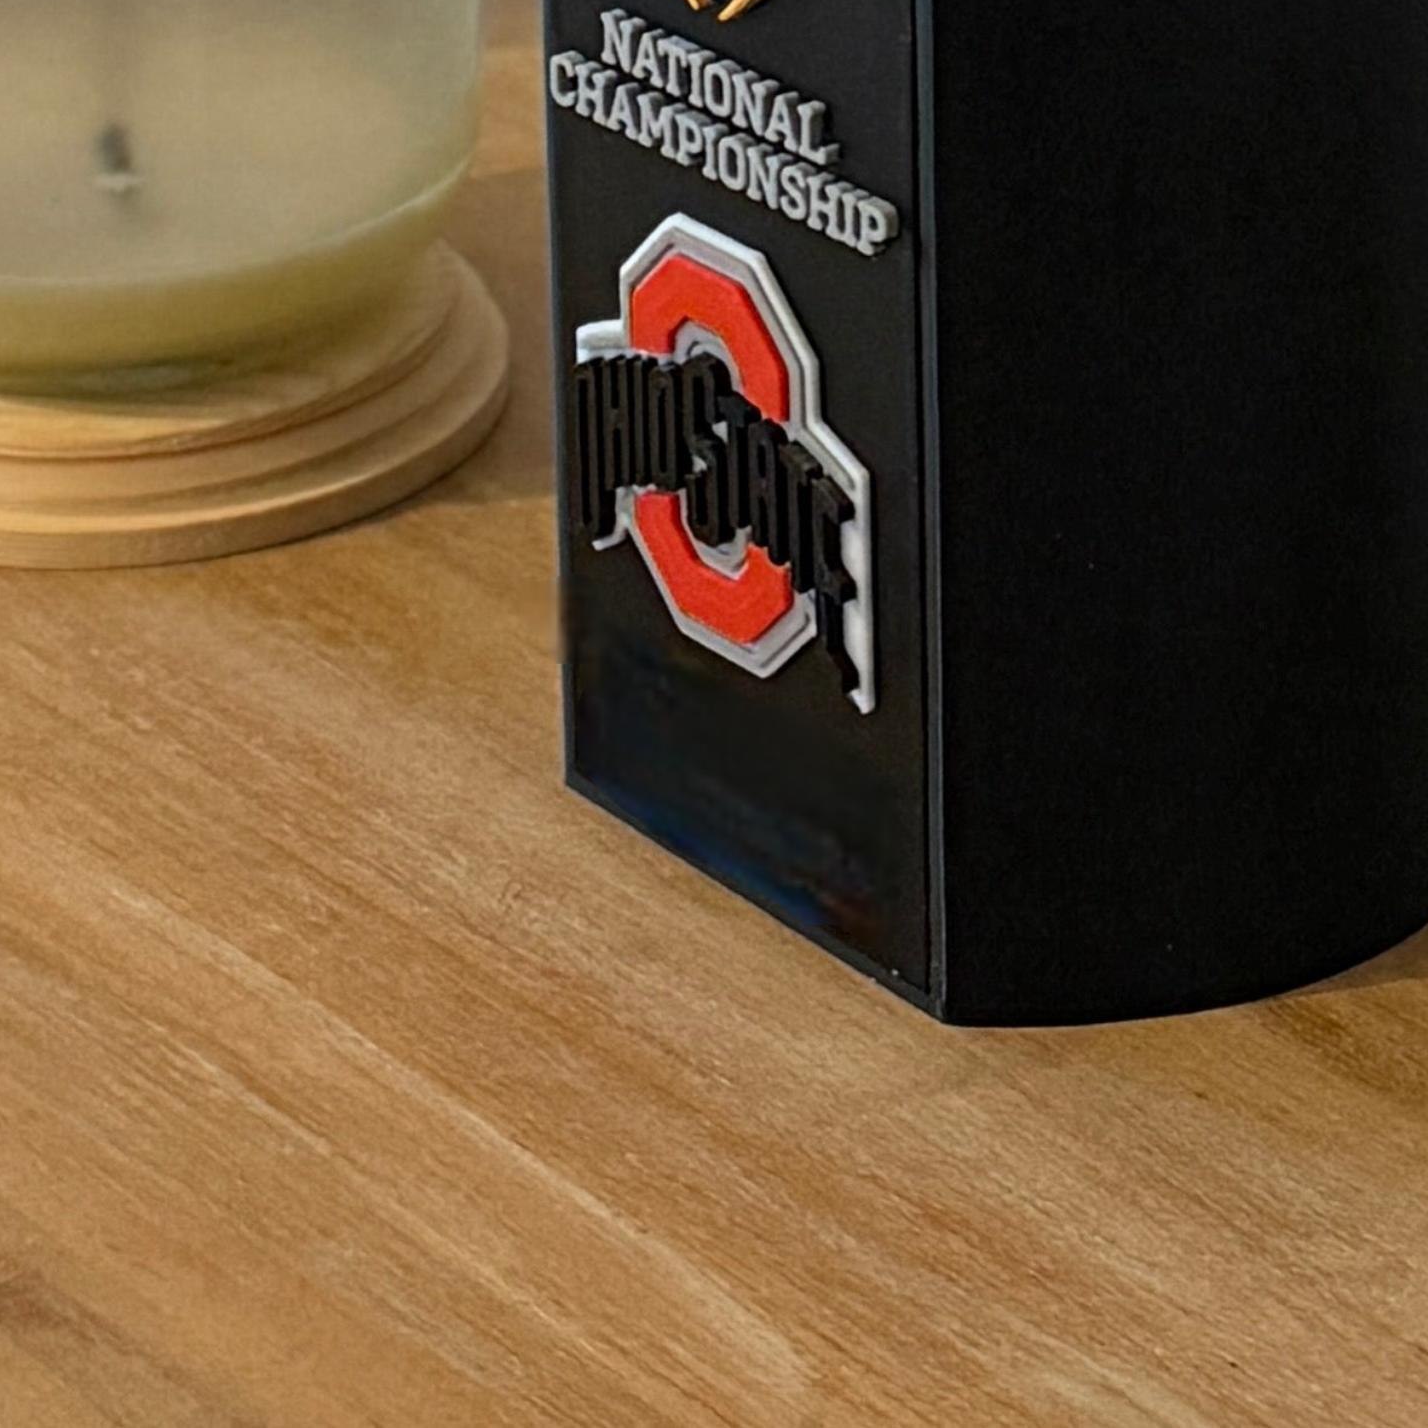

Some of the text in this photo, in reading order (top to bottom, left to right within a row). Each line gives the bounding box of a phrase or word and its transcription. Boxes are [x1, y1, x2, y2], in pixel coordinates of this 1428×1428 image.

[549, 49, 900, 257] CHAMPIONSHIP
[599, 7, 840, 166] NATIONAL
[573, 355, 681, 540] OHIO
